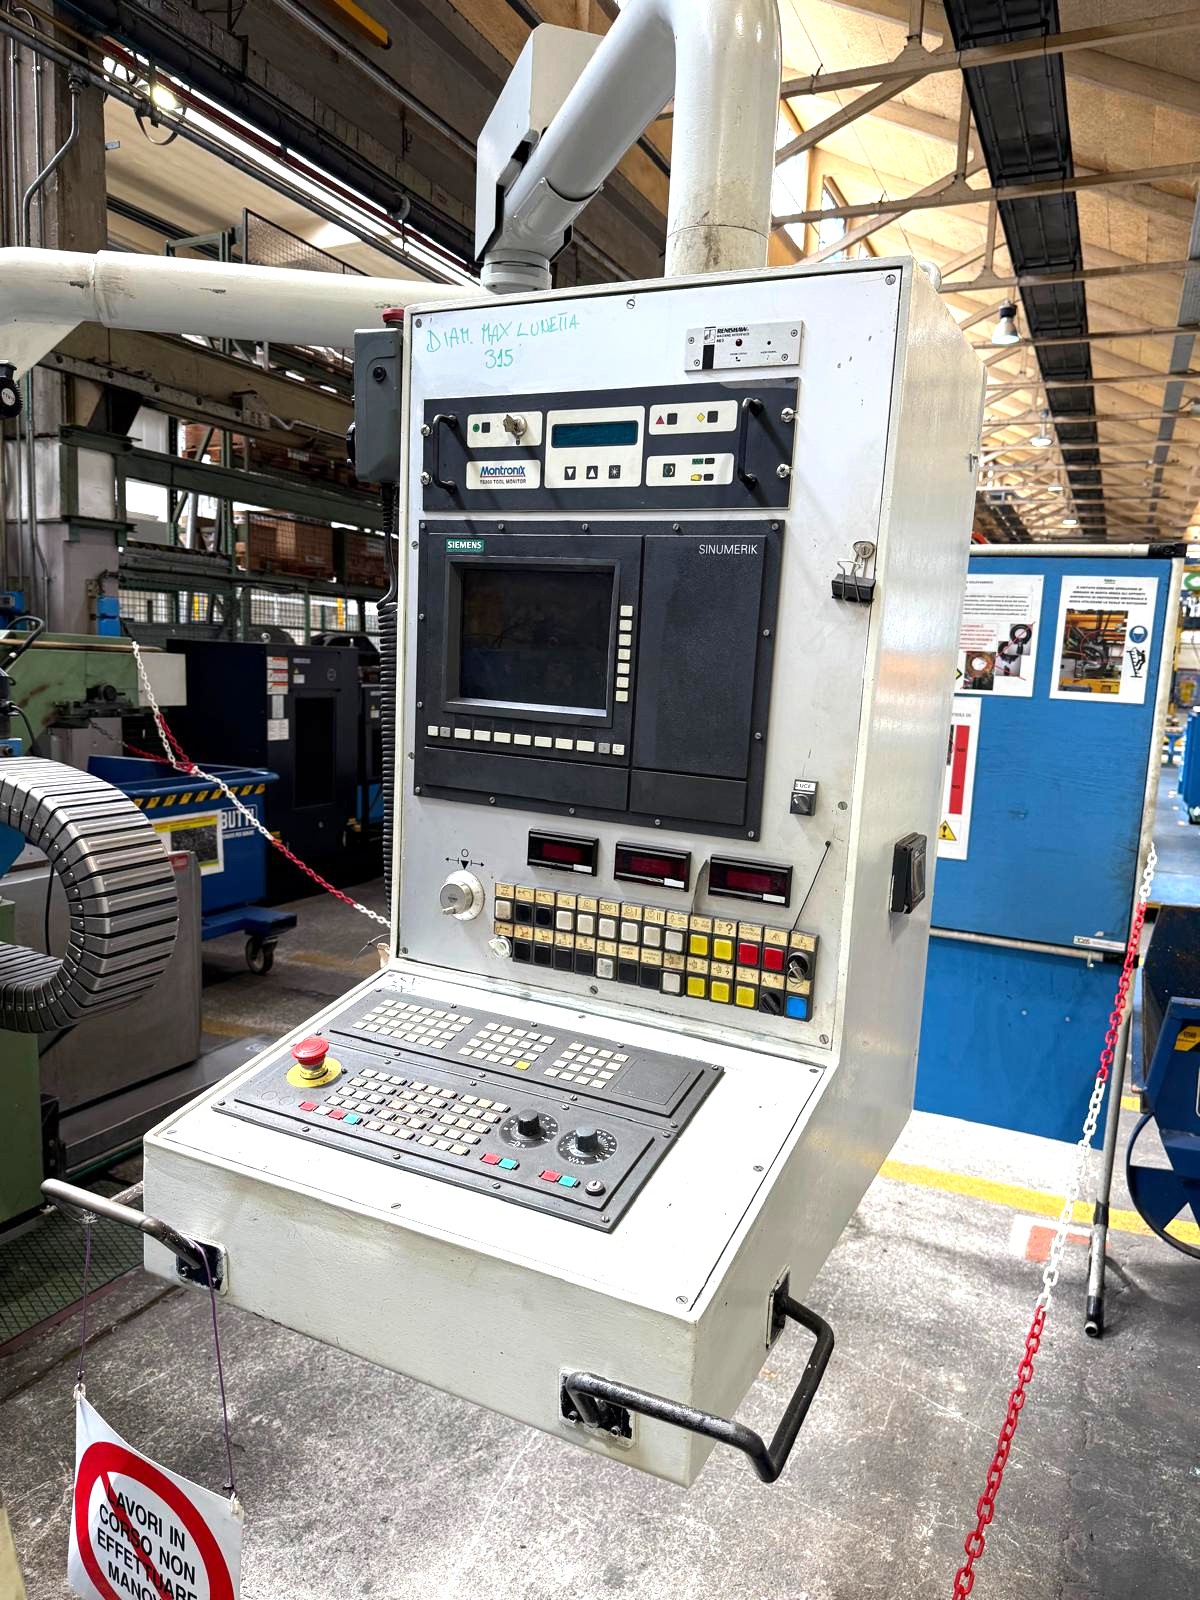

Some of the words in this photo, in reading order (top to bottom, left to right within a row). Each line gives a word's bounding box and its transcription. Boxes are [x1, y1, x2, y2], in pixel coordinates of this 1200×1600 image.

[427, 328, 473, 353] DIAM.
[482, 321, 512, 345] MAX
[517, 312, 580, 337] LUNETTA
[717, 326, 748, 334] RENISHAW
[484, 349, 514, 369] 315
[480, 466, 526, 478] Montronix
[447, 541, 482, 549] SIEMENS
[699, 544, 758, 555] SINUMERIK
[107, 1483, 163, 1538] LAVORI
[169, 1525, 185, 1552] IN
[99, 1503, 153, 1557] CORSO
[159, 1545, 196, 1586] NON
[108, 1560, 162, 1600] MANO
